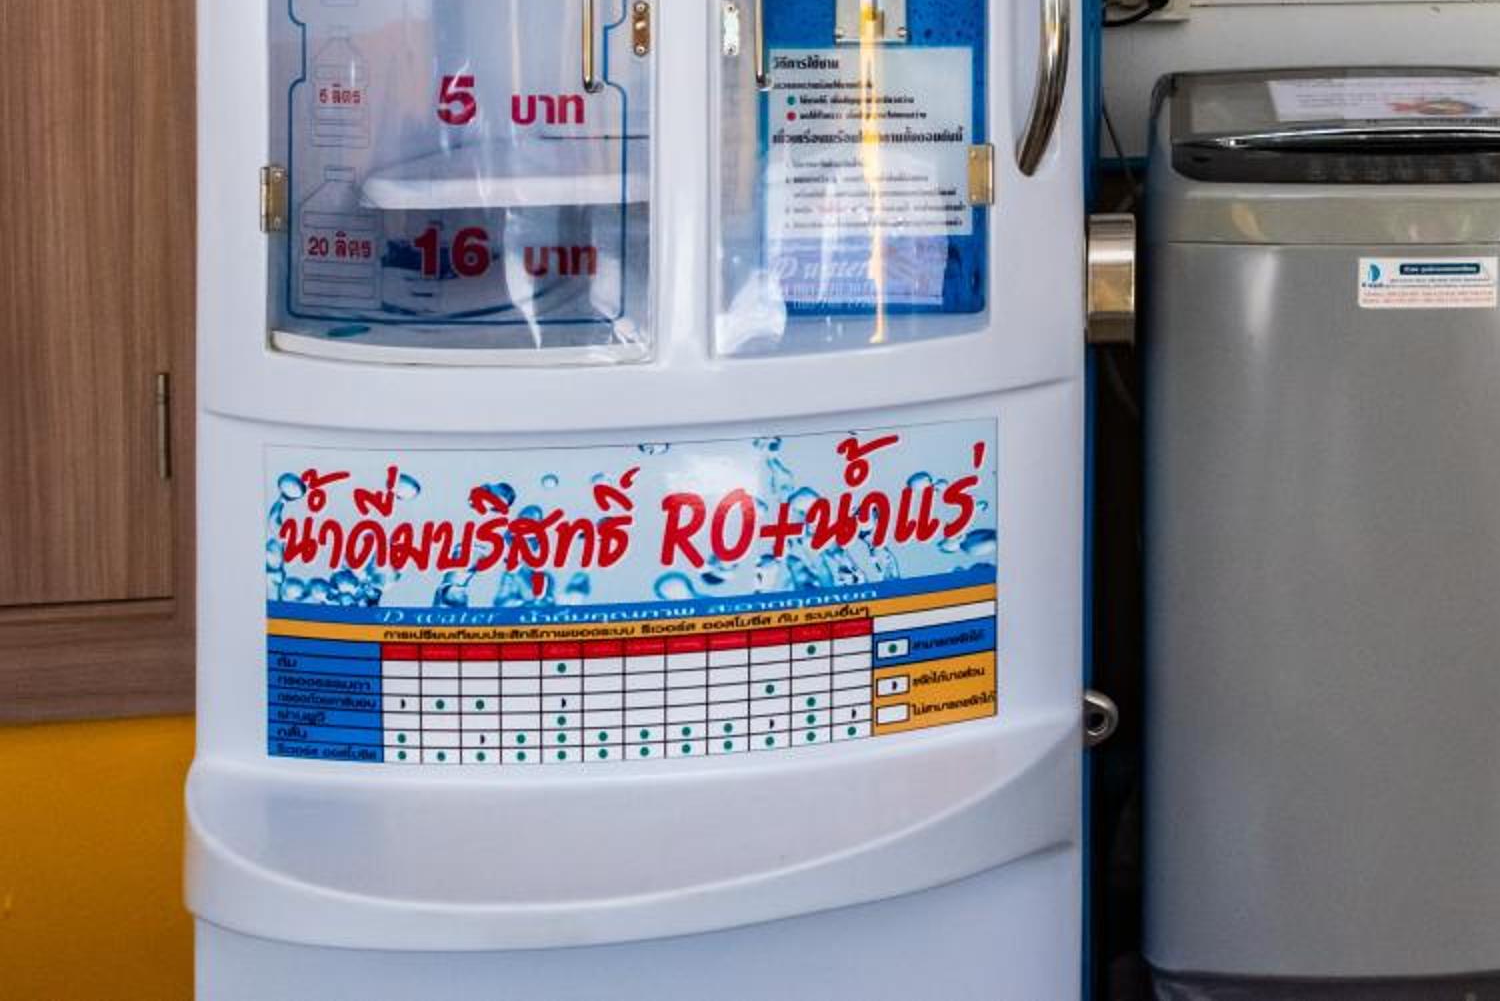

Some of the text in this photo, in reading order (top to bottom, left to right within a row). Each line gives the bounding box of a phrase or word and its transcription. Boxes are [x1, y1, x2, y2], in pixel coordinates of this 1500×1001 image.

[437, 75, 585, 126] 5 บาท
[307, 230, 373, 260] 20 ลิตร
[414, 226, 598, 279] 16 บาท
[279, 465, 643, 597] น้ำดื่มบริสุทธิ์
[417, 610, 498, 625] water
